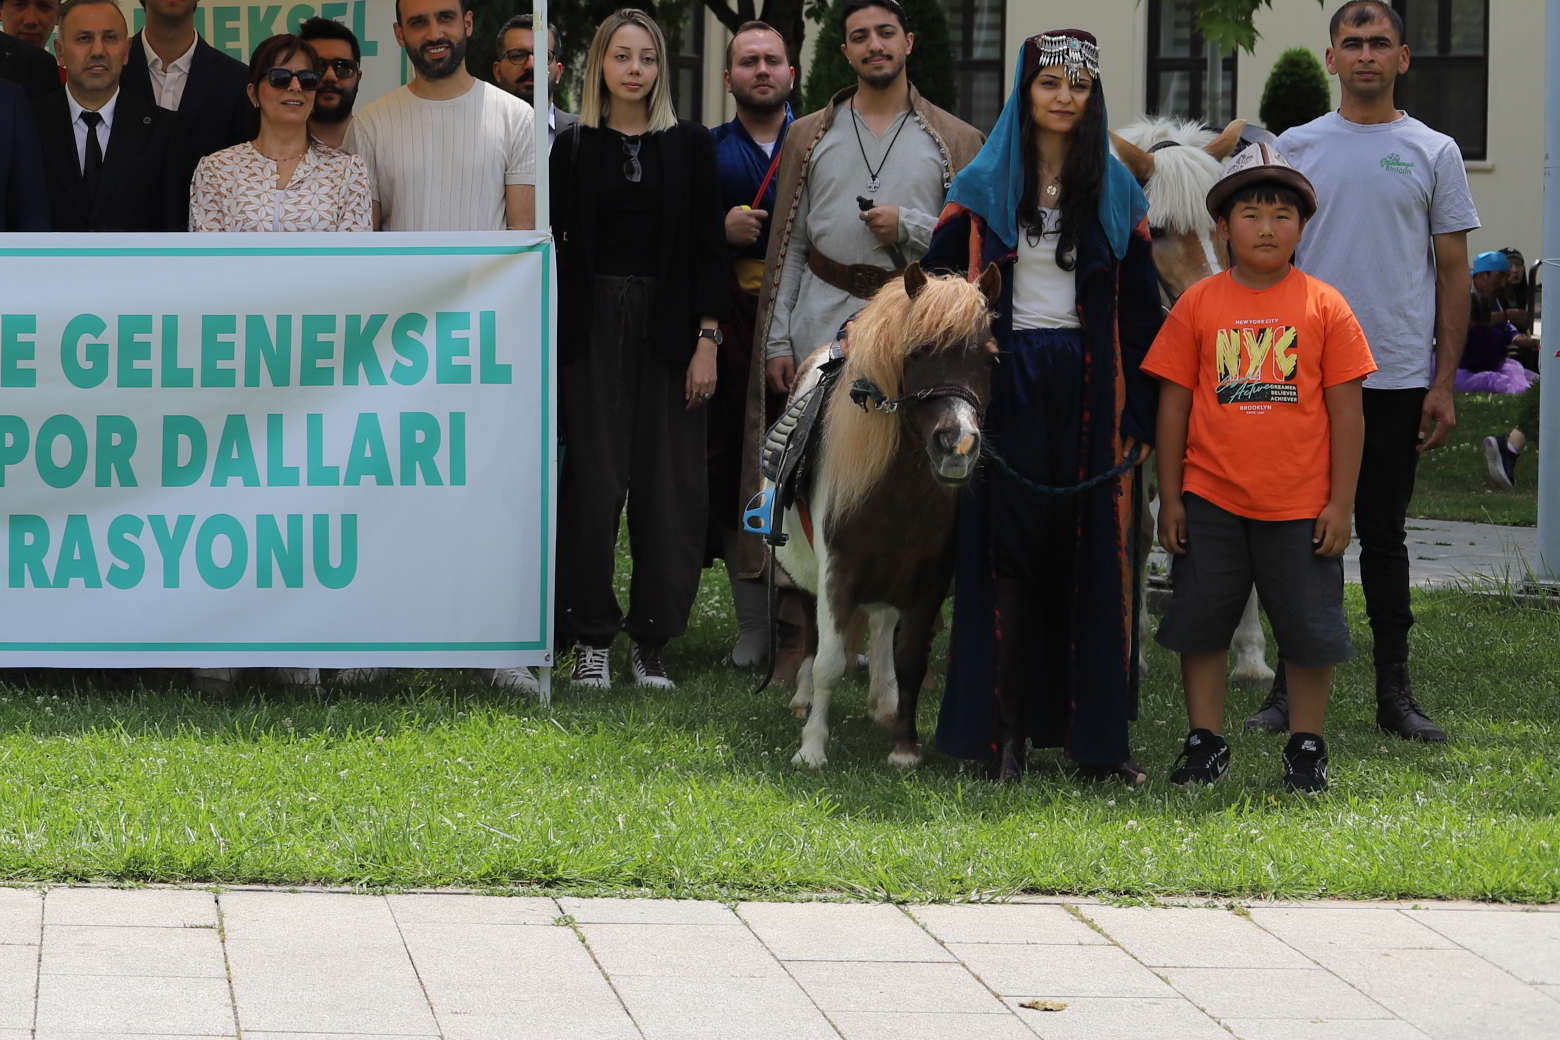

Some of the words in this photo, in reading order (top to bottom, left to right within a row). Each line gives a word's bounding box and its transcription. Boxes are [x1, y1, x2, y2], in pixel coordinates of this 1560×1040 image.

[60, 310, 513, 389] GELENEKSEL
[1216, 326, 1298, 383] NYC
[161, 411, 467, 488] DALLARI
